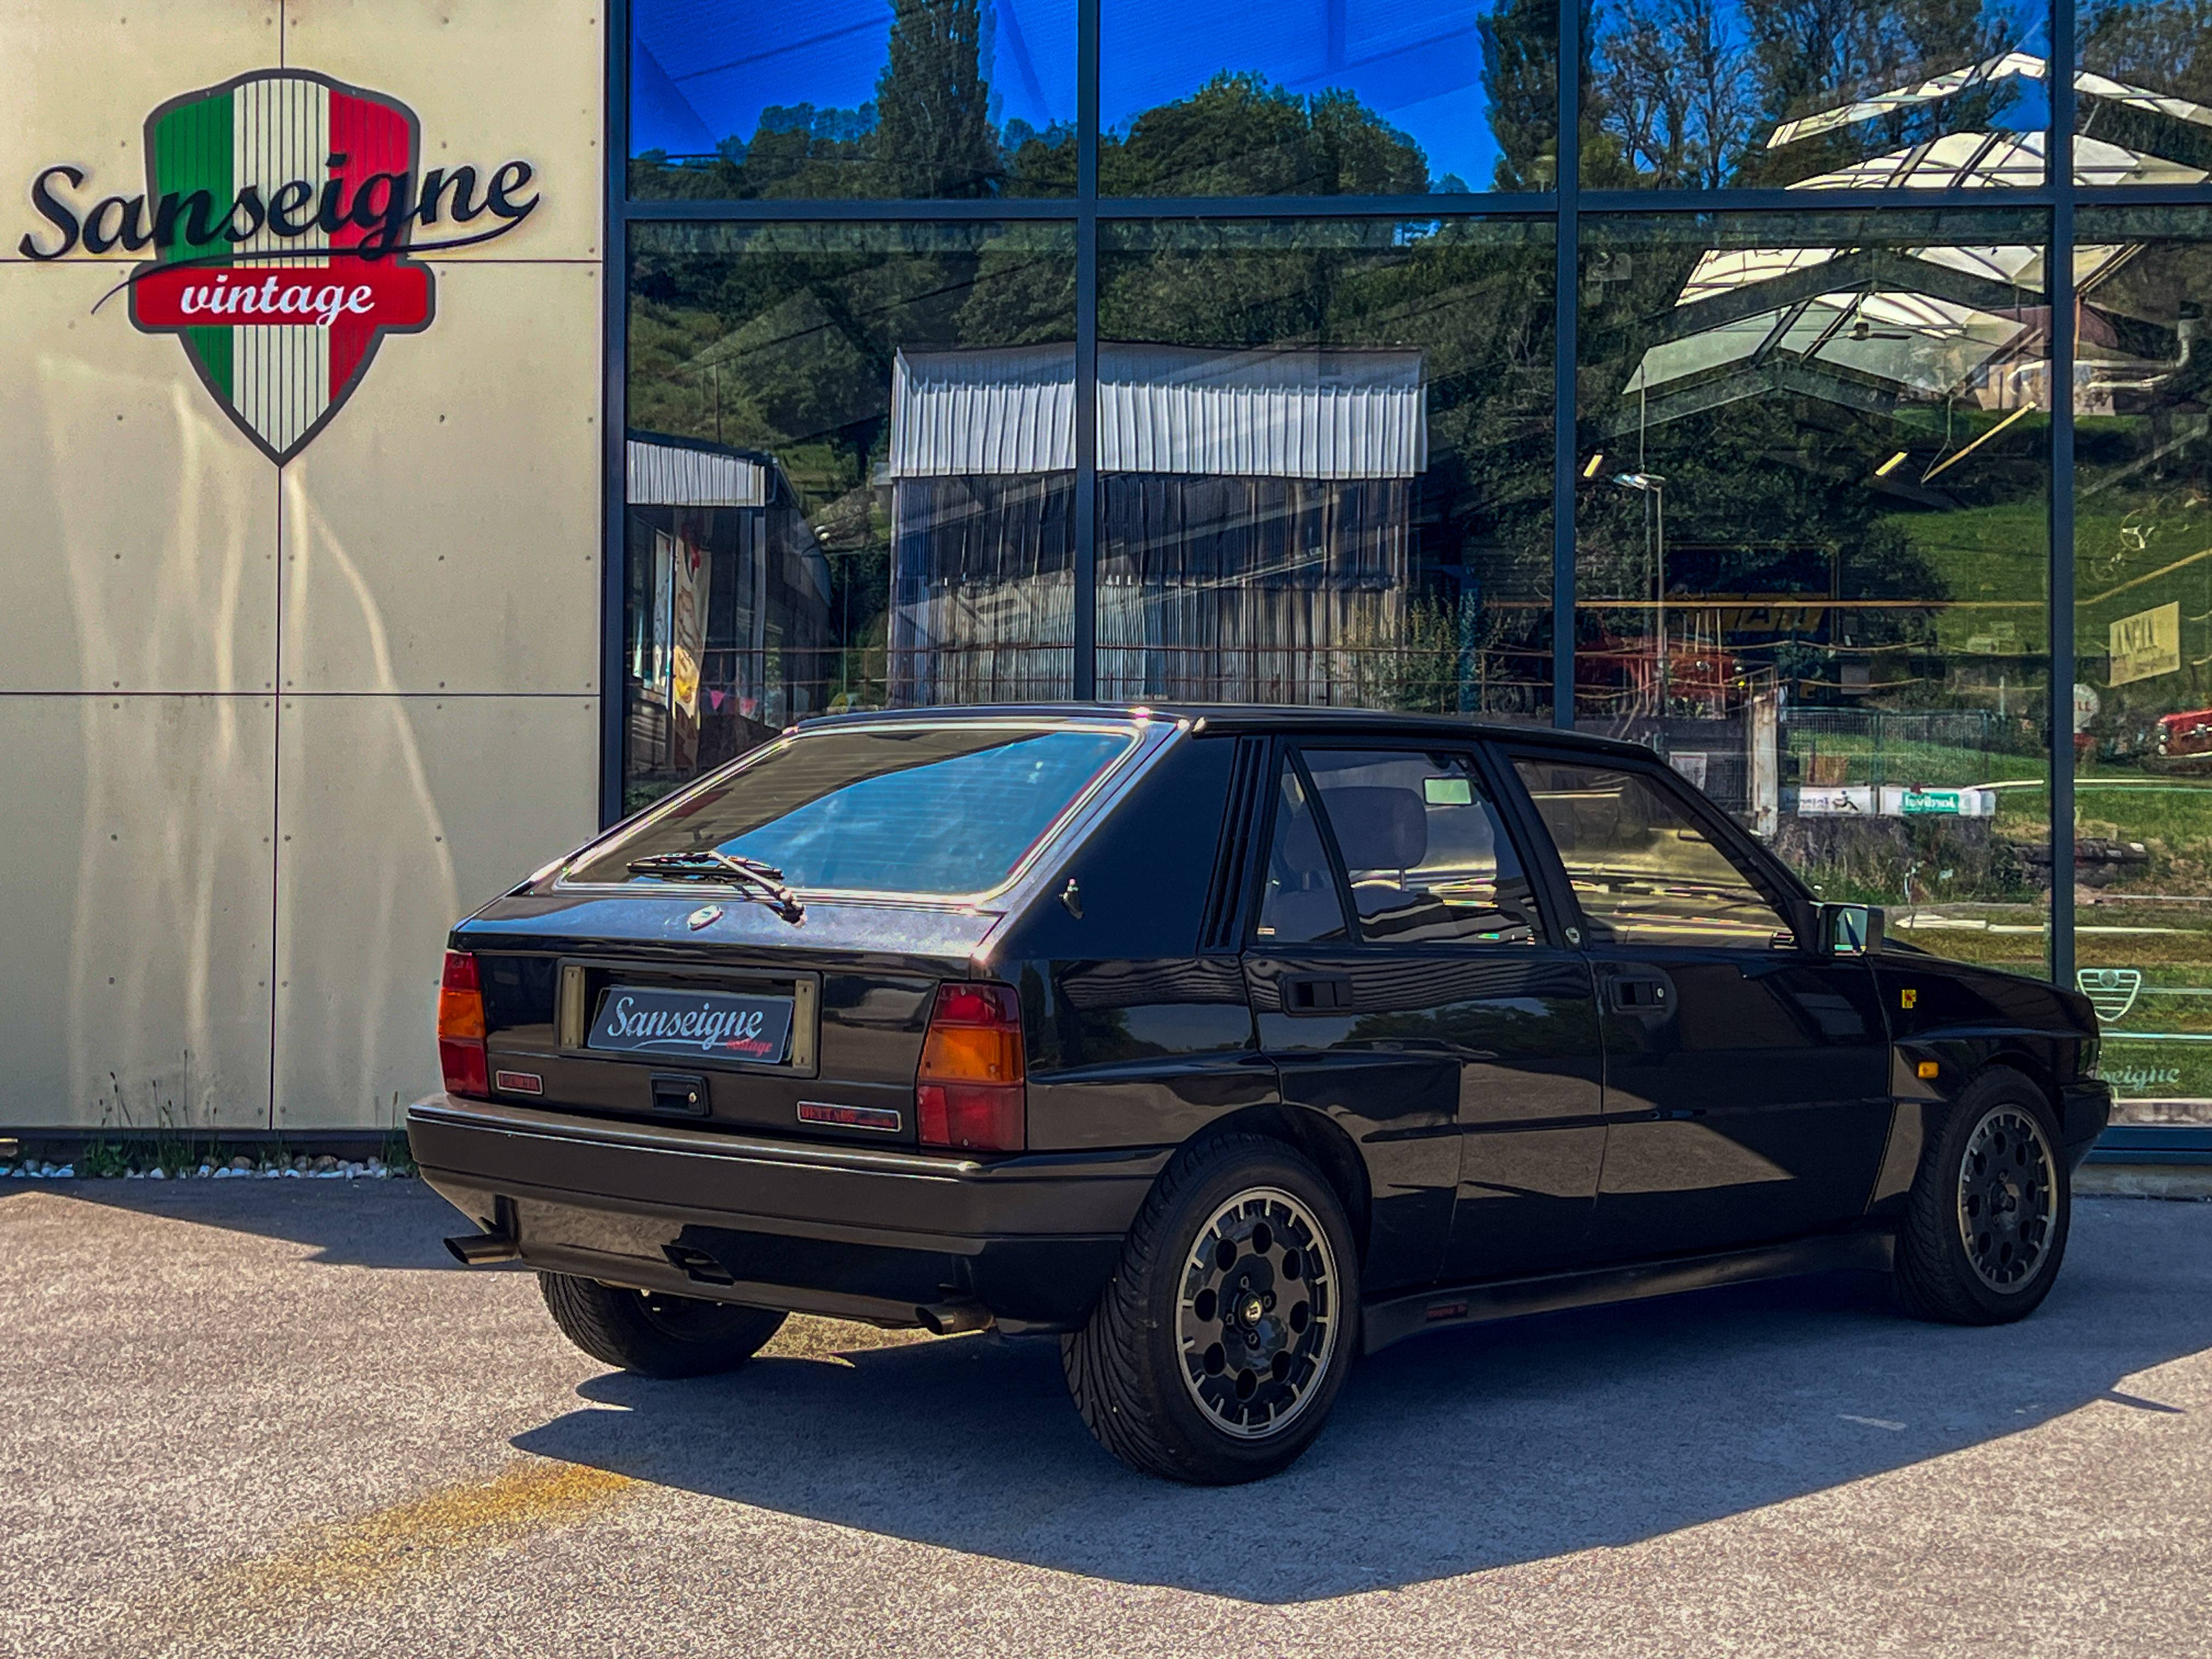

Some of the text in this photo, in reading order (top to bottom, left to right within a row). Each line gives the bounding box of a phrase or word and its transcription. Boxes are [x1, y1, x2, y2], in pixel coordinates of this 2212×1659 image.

[19, 154, 541, 261] Sanseigne
[180, 274, 376, 326] vintage
[607, 996, 764, 1051] Sanseigne
[2101, 1065, 2180, 1092] seigne
